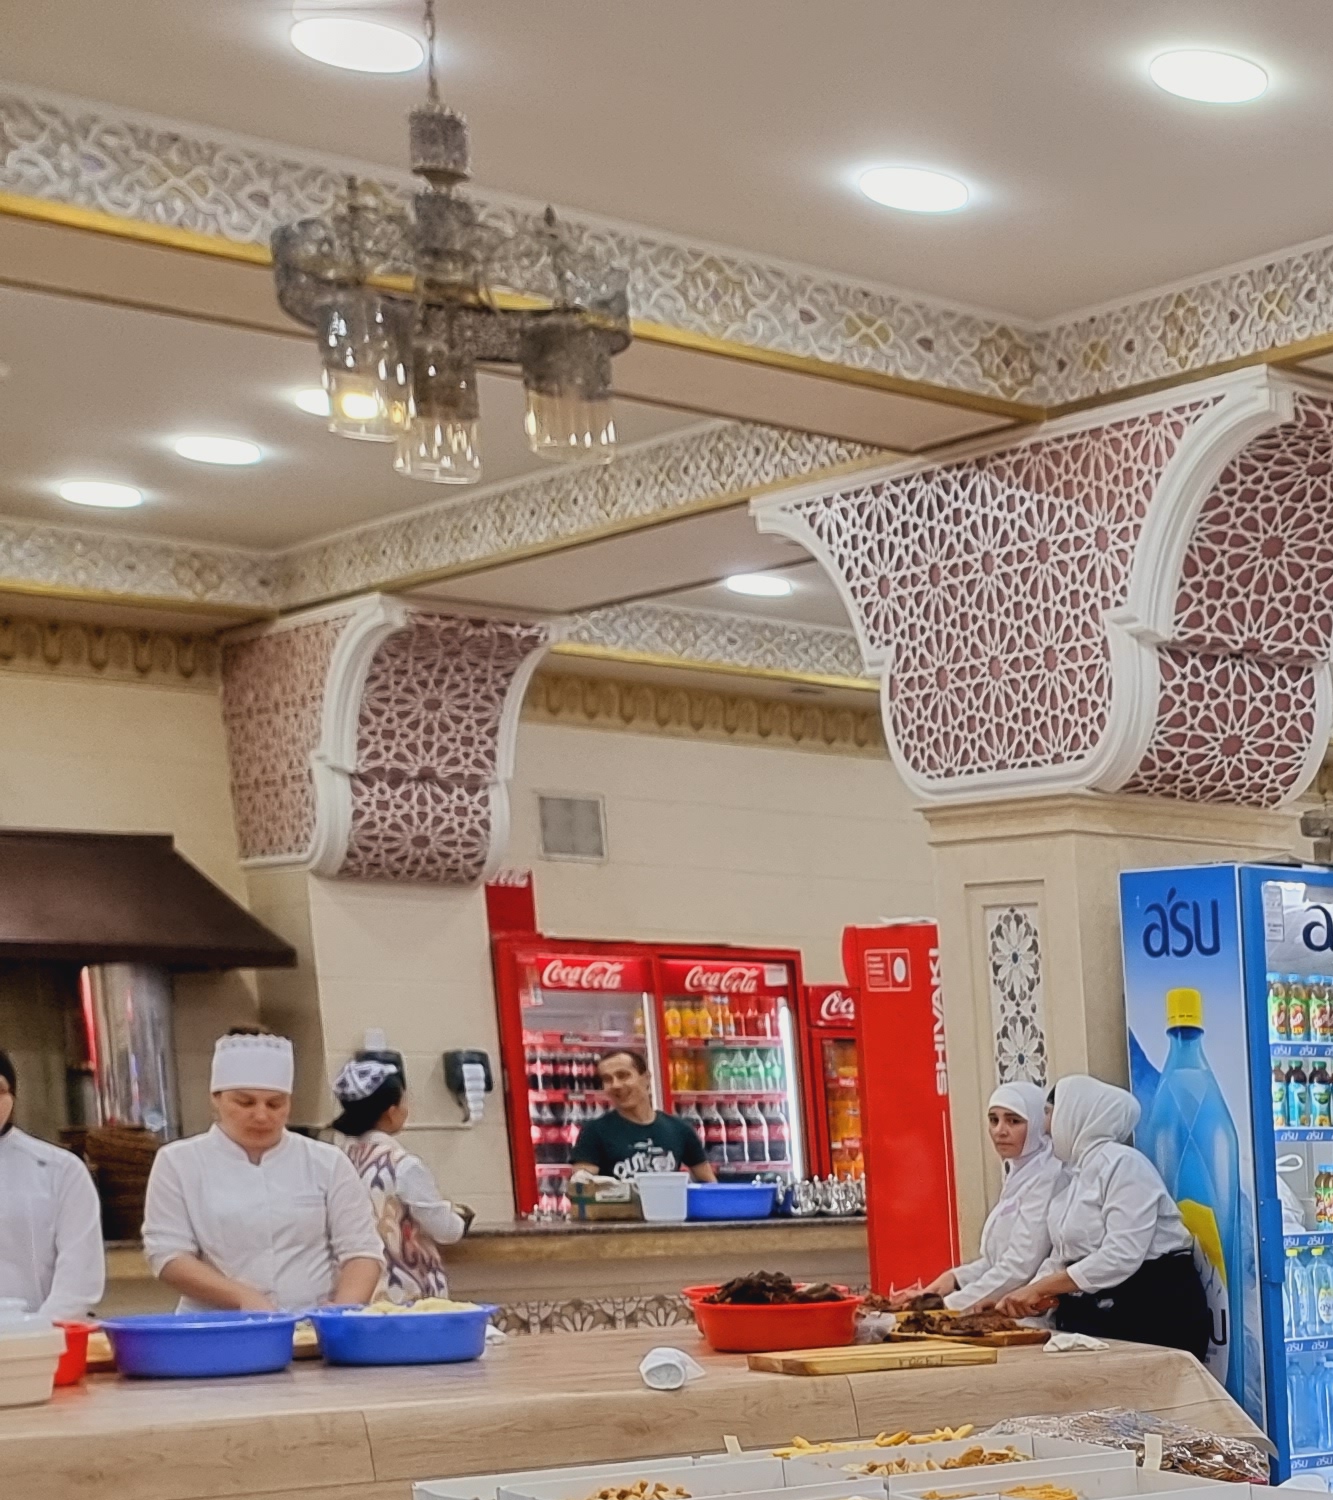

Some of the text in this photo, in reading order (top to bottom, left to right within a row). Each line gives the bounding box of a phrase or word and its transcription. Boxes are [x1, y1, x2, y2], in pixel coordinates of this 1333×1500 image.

[542, 959, 624, 990] Coca-Cola
[684, 965, 760, 994] Coca-Cola
[929, 948, 948, 1096] SHIVAKI
